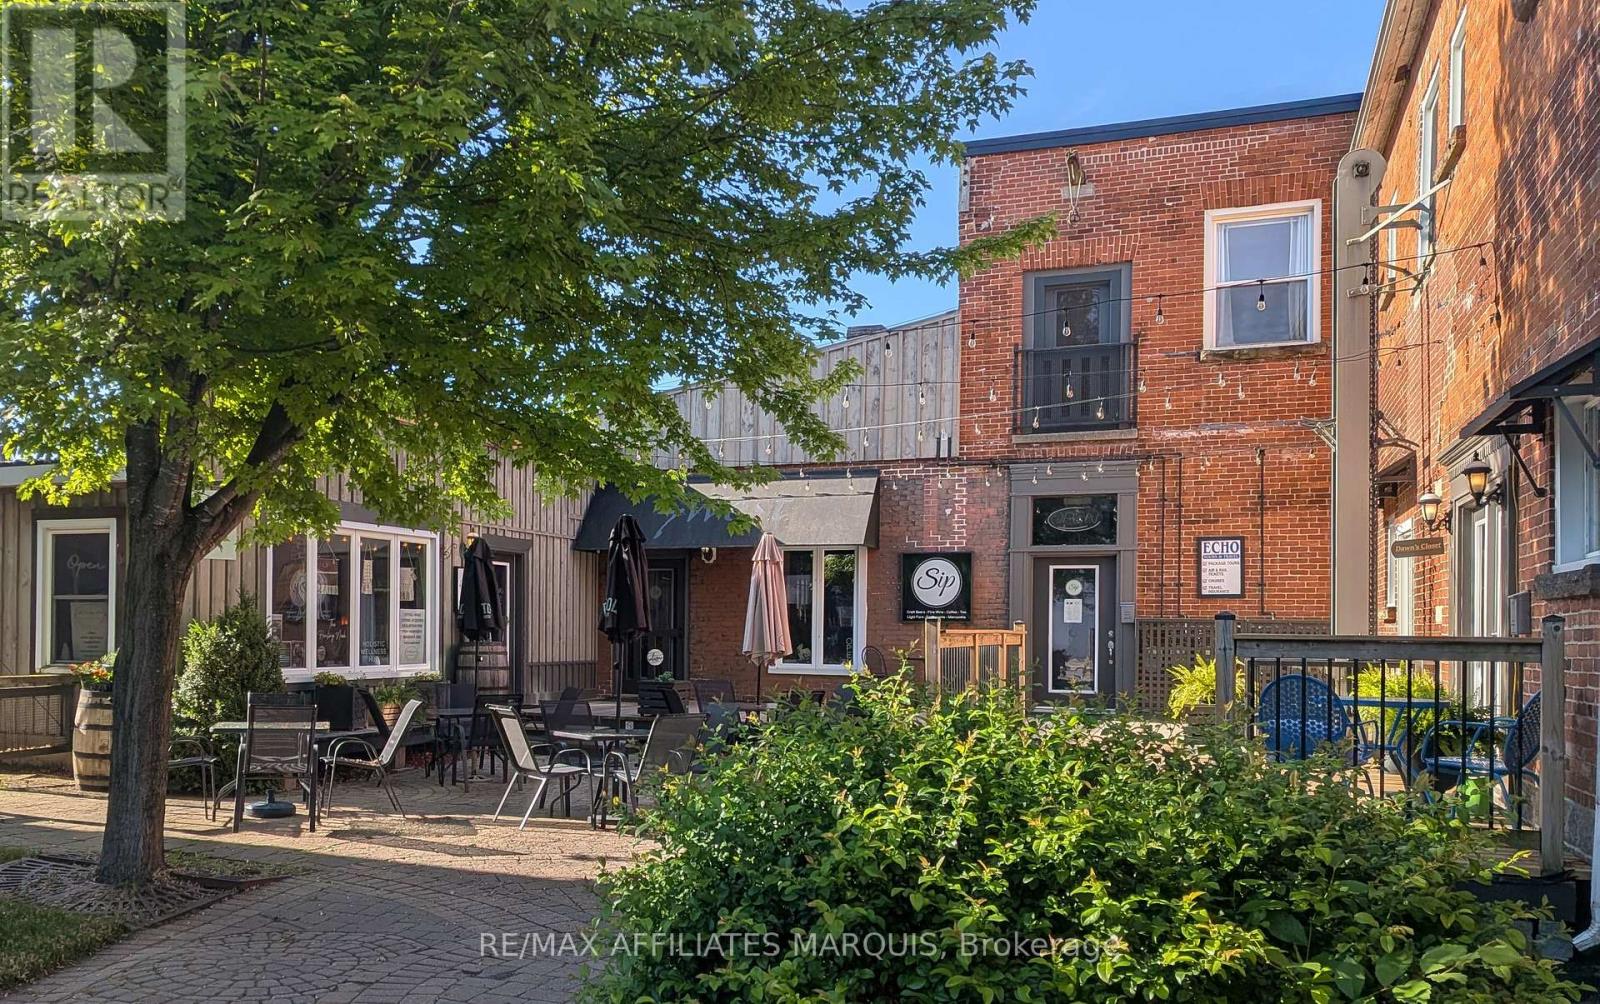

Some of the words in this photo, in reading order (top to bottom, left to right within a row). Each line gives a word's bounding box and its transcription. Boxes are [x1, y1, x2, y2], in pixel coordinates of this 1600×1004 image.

[1203, 541, 1240, 554] ECHO
[1395, 544, 1420, 552] Dawn's
[1420, 542, 1442, 551] Closet
[67, 554, 106, 576] Open
[917, 567, 956, 597] Sip
